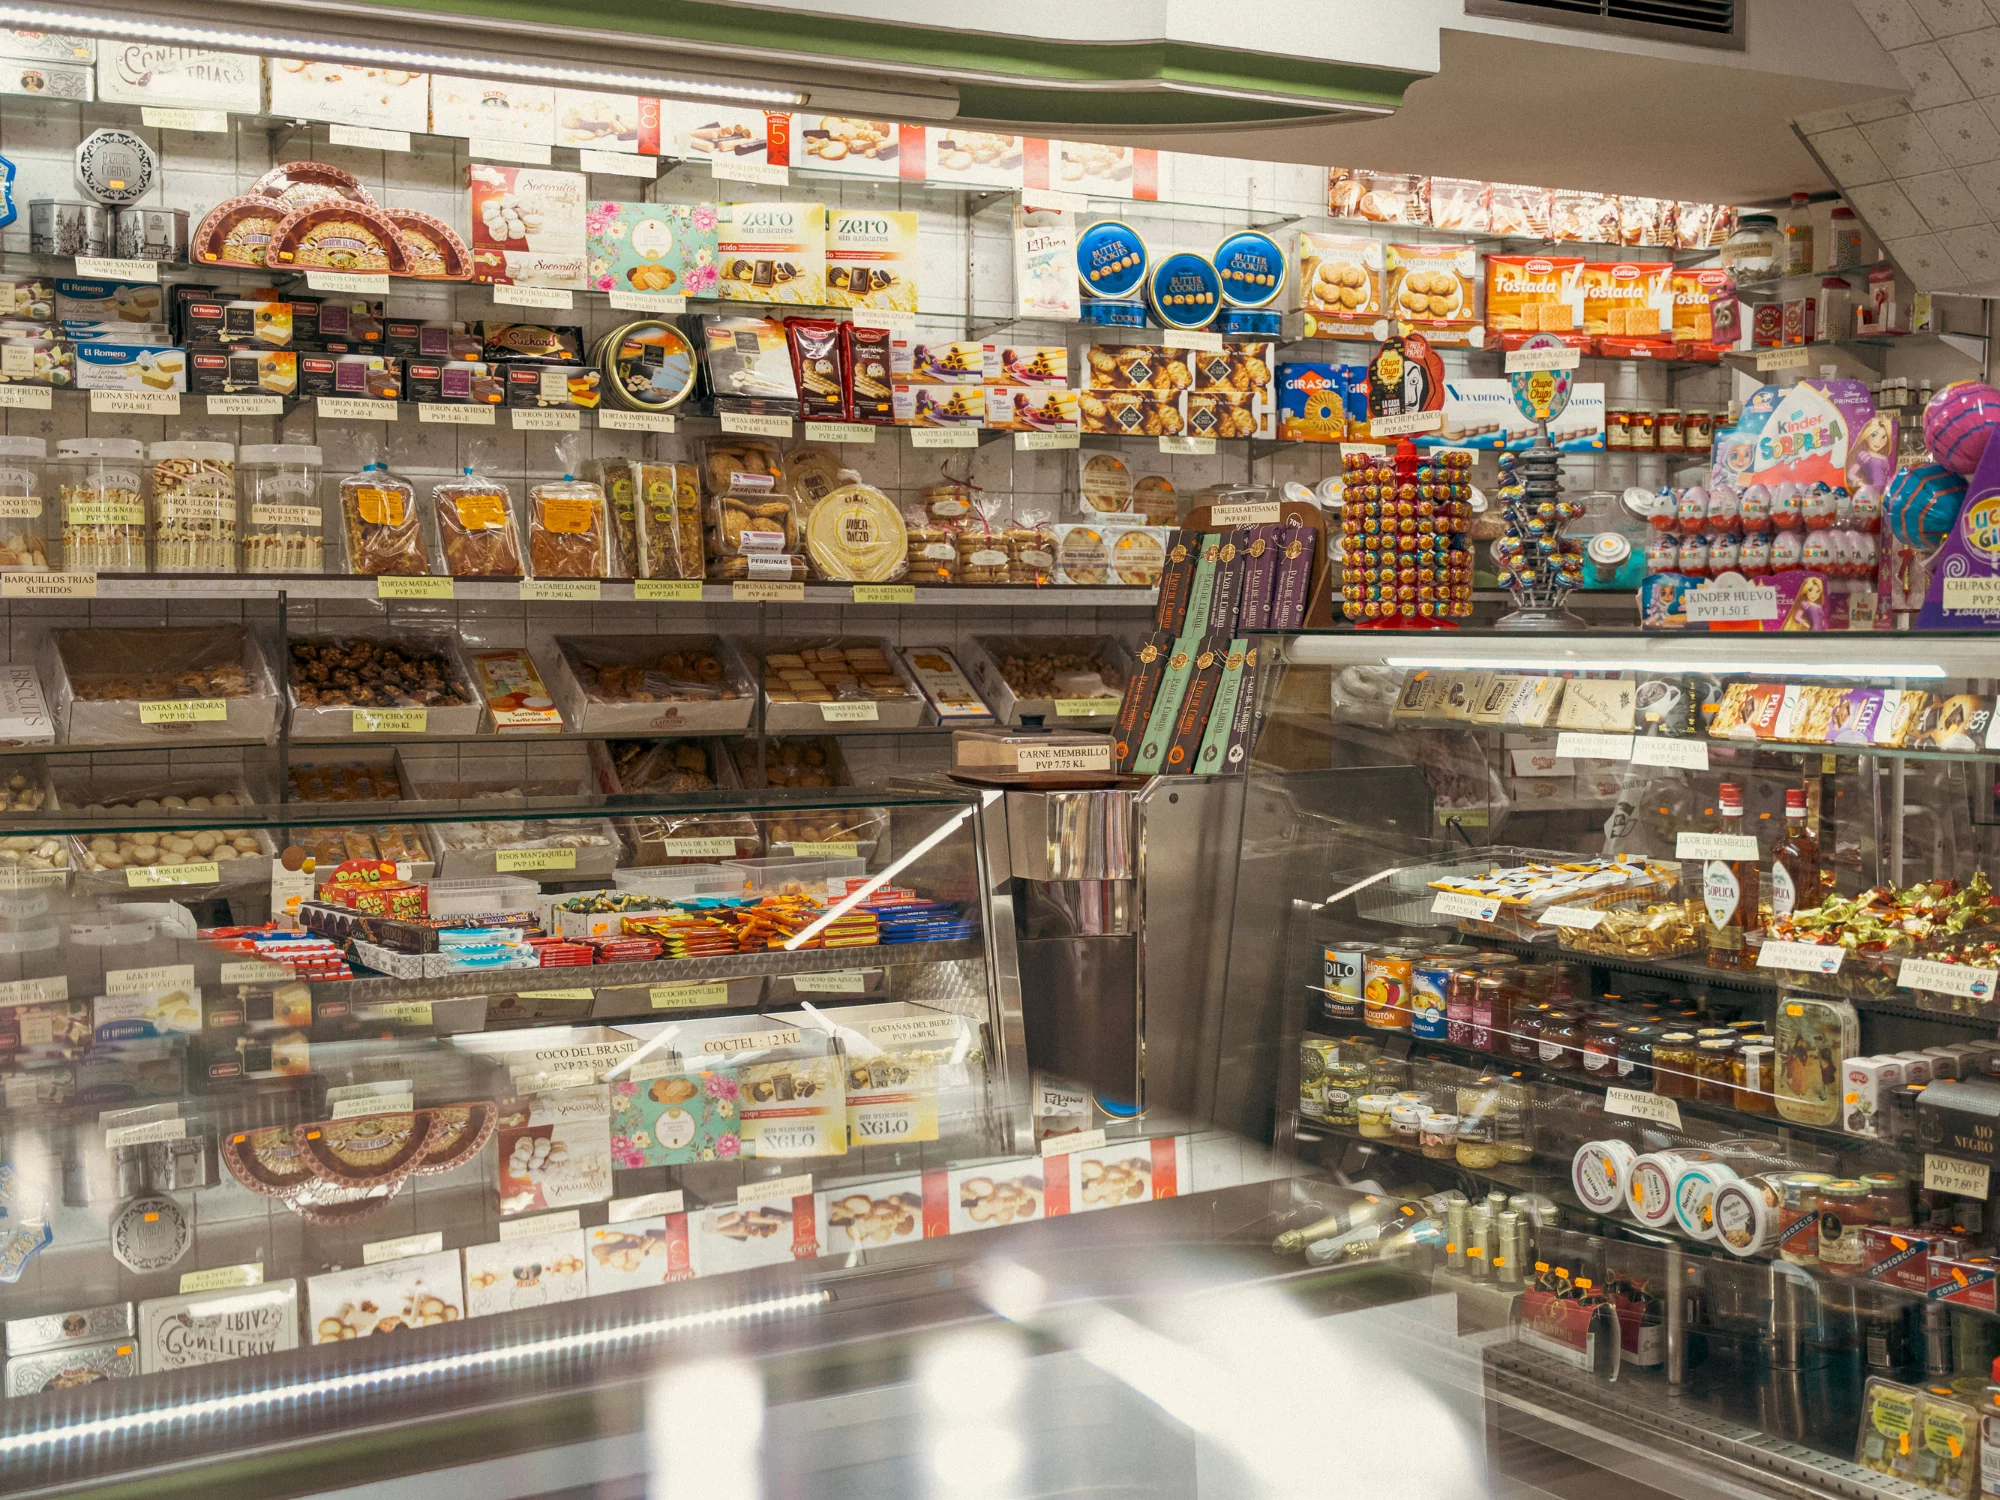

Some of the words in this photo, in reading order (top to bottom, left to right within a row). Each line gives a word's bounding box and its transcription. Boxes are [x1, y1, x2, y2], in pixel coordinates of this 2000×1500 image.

[641, 105, 657, 128] 8
[771, 124, 786, 144] 5
[742, 212, 793, 226] zero
[839, 219, 888, 234] zero
[1092, 241, 1123, 259] BUTTER
[1093, 248, 1128, 267] COOKIES
[1235, 252, 1267, 265] BUTTER
[79, 260, 100, 268] LATAS
[115, 261, 154, 269] SANTIAGO
[1231, 260, 1268, 273] COOKIES
[1526, 261, 1552, 273] Cuétara
[1613, 267, 1639, 278] Cuétara
[343, 276, 387, 284] CHOCOLATE
[1171, 276, 1202, 286] BUTTER
[1699, 274, 1725, 284] Cuétara
[1170, 284, 1204, 293] COOKIES
[1494, 277, 1556, 294] Tostada
[1582, 283, 1643, 299] Tostada
[496, 287, 526, 295] SURTIDO
[529, 289, 570, 299] HOJALDRES
[1756, 309, 1780, 319] ROYAL
[508, 332, 556, 347] Suchard
[93, 349, 126, 358] Romero
[1128, 351, 1152, 359] TEJAS
[1407, 349, 1424, 358] PAPEL
[1380, 359, 1400, 368] Chupa
[1380, 366, 1401, 377] Chups
[1286, 379, 1339, 390] GIRASOL
[1532, 379, 1552, 389] Chupa
[92, 391, 124, 400] JIJONA
[141, 393, 177, 401] AZUCAR
[1531, 389, 1551, 400] Chups
[1833, 395, 1868, 404] PRINCESS
[1389, 399, 1400, 407] CASA
[1393, 416, 1411, 424] CHUP
[1413, 412, 1440, 421] CLASICO
[1777, 413, 1823, 435] Kinder
[844, 425, 873, 433] CUETARA
[913, 430, 948, 438] CANUTILLO
[1760, 422, 1843, 460] SORPRESA
[164, 499, 214, 508] BARQUILLOS
[1243, 505, 1278, 513] ARTESANAS
[70, 506, 116, 514] BARQUILLOS
[254, 506, 300, 516] BARQUILLOS
[751, 558, 788, 566] PERRUNAS
[4, 576, 64, 584] BARQUILLOS
[66, 576, 94, 584] TRIAS
[1171, 573, 1180, 591] PAZO
[1224, 571, 1233, 590] PAZO
[1947, 582, 1990, 590] CHUPAS
[26, 586, 72, 594] SURTIDOS
[1689, 591, 1731, 602] KINDER
[1733, 590, 1773, 602] HUEVO
[1162, 603, 1174, 628] CORUXO
[1698, 606, 1722, 616] PVP
[1724, 606, 1741, 616] 1.50
[1418, 679, 1430, 708] POSTRES
[1434, 675, 1450, 706] Negro
[1494, 681, 1513, 710] POSTRES
[10, 670, 44, 727] BISCUITS
[1508, 680, 1530, 714] Blanco
[173, 702, 224, 710] ALMENDRAS
[1760, 693, 1781, 728] PURO
[1856, 696, 1880, 734] LECHE
[1969, 710, 1990, 730] 85
[1019, 750, 1052, 760] CARNE
[1053, 748, 1108, 758] MEMBRILLO
[1036, 761, 1052, 769] PVP
[1054, 760, 1071, 769] 7.75
[1073, 760, 1086, 768] KL
[1702, 837, 1712, 846] DE
[1714, 837, 1756, 848] MEMBRILLO
[382, 926, 402, 939] CHOCO
[1370, 963, 1388, 973] eliges
[1902, 962, 1938, 976] CEREZAS
[1940, 968, 1992, 982] CHOCOLATE
[652, 990, 685, 998] BIZCOCHO
[688, 988, 724, 996] ENVUELTO
[411, 1006, 430, 1014] MIEL
[872, 1020, 910, 1033] CASTAÑAS
[913, 1021, 927, 1029] DEL
[704, 1036, 757, 1053] COCTEL
[767, 1035, 780, 1046] 12
[783, 1032, 801, 1045] KL
[536, 1050, 569, 1060] COCO
[572, 1048, 594, 1058] DEL
[598, 1042, 637, 1056] BRASIL
[1329, 1091, 1348, 1100] ALSUR
[1608, 1090, 1664, 1107] MERMELADA
[1973, 1125, 1993, 1138] AJO
[1955, 1136, 1993, 1152] NEGRO
[1929, 1160, 1948, 1170] AJO
[1950, 1162, 1985, 1177] NEGRO
[1933, 1175, 1952, 1187] PVP
[1954, 1179, 1971, 1190] 7.60
[1872, 1247, 1916, 1275] CONSORCIO
